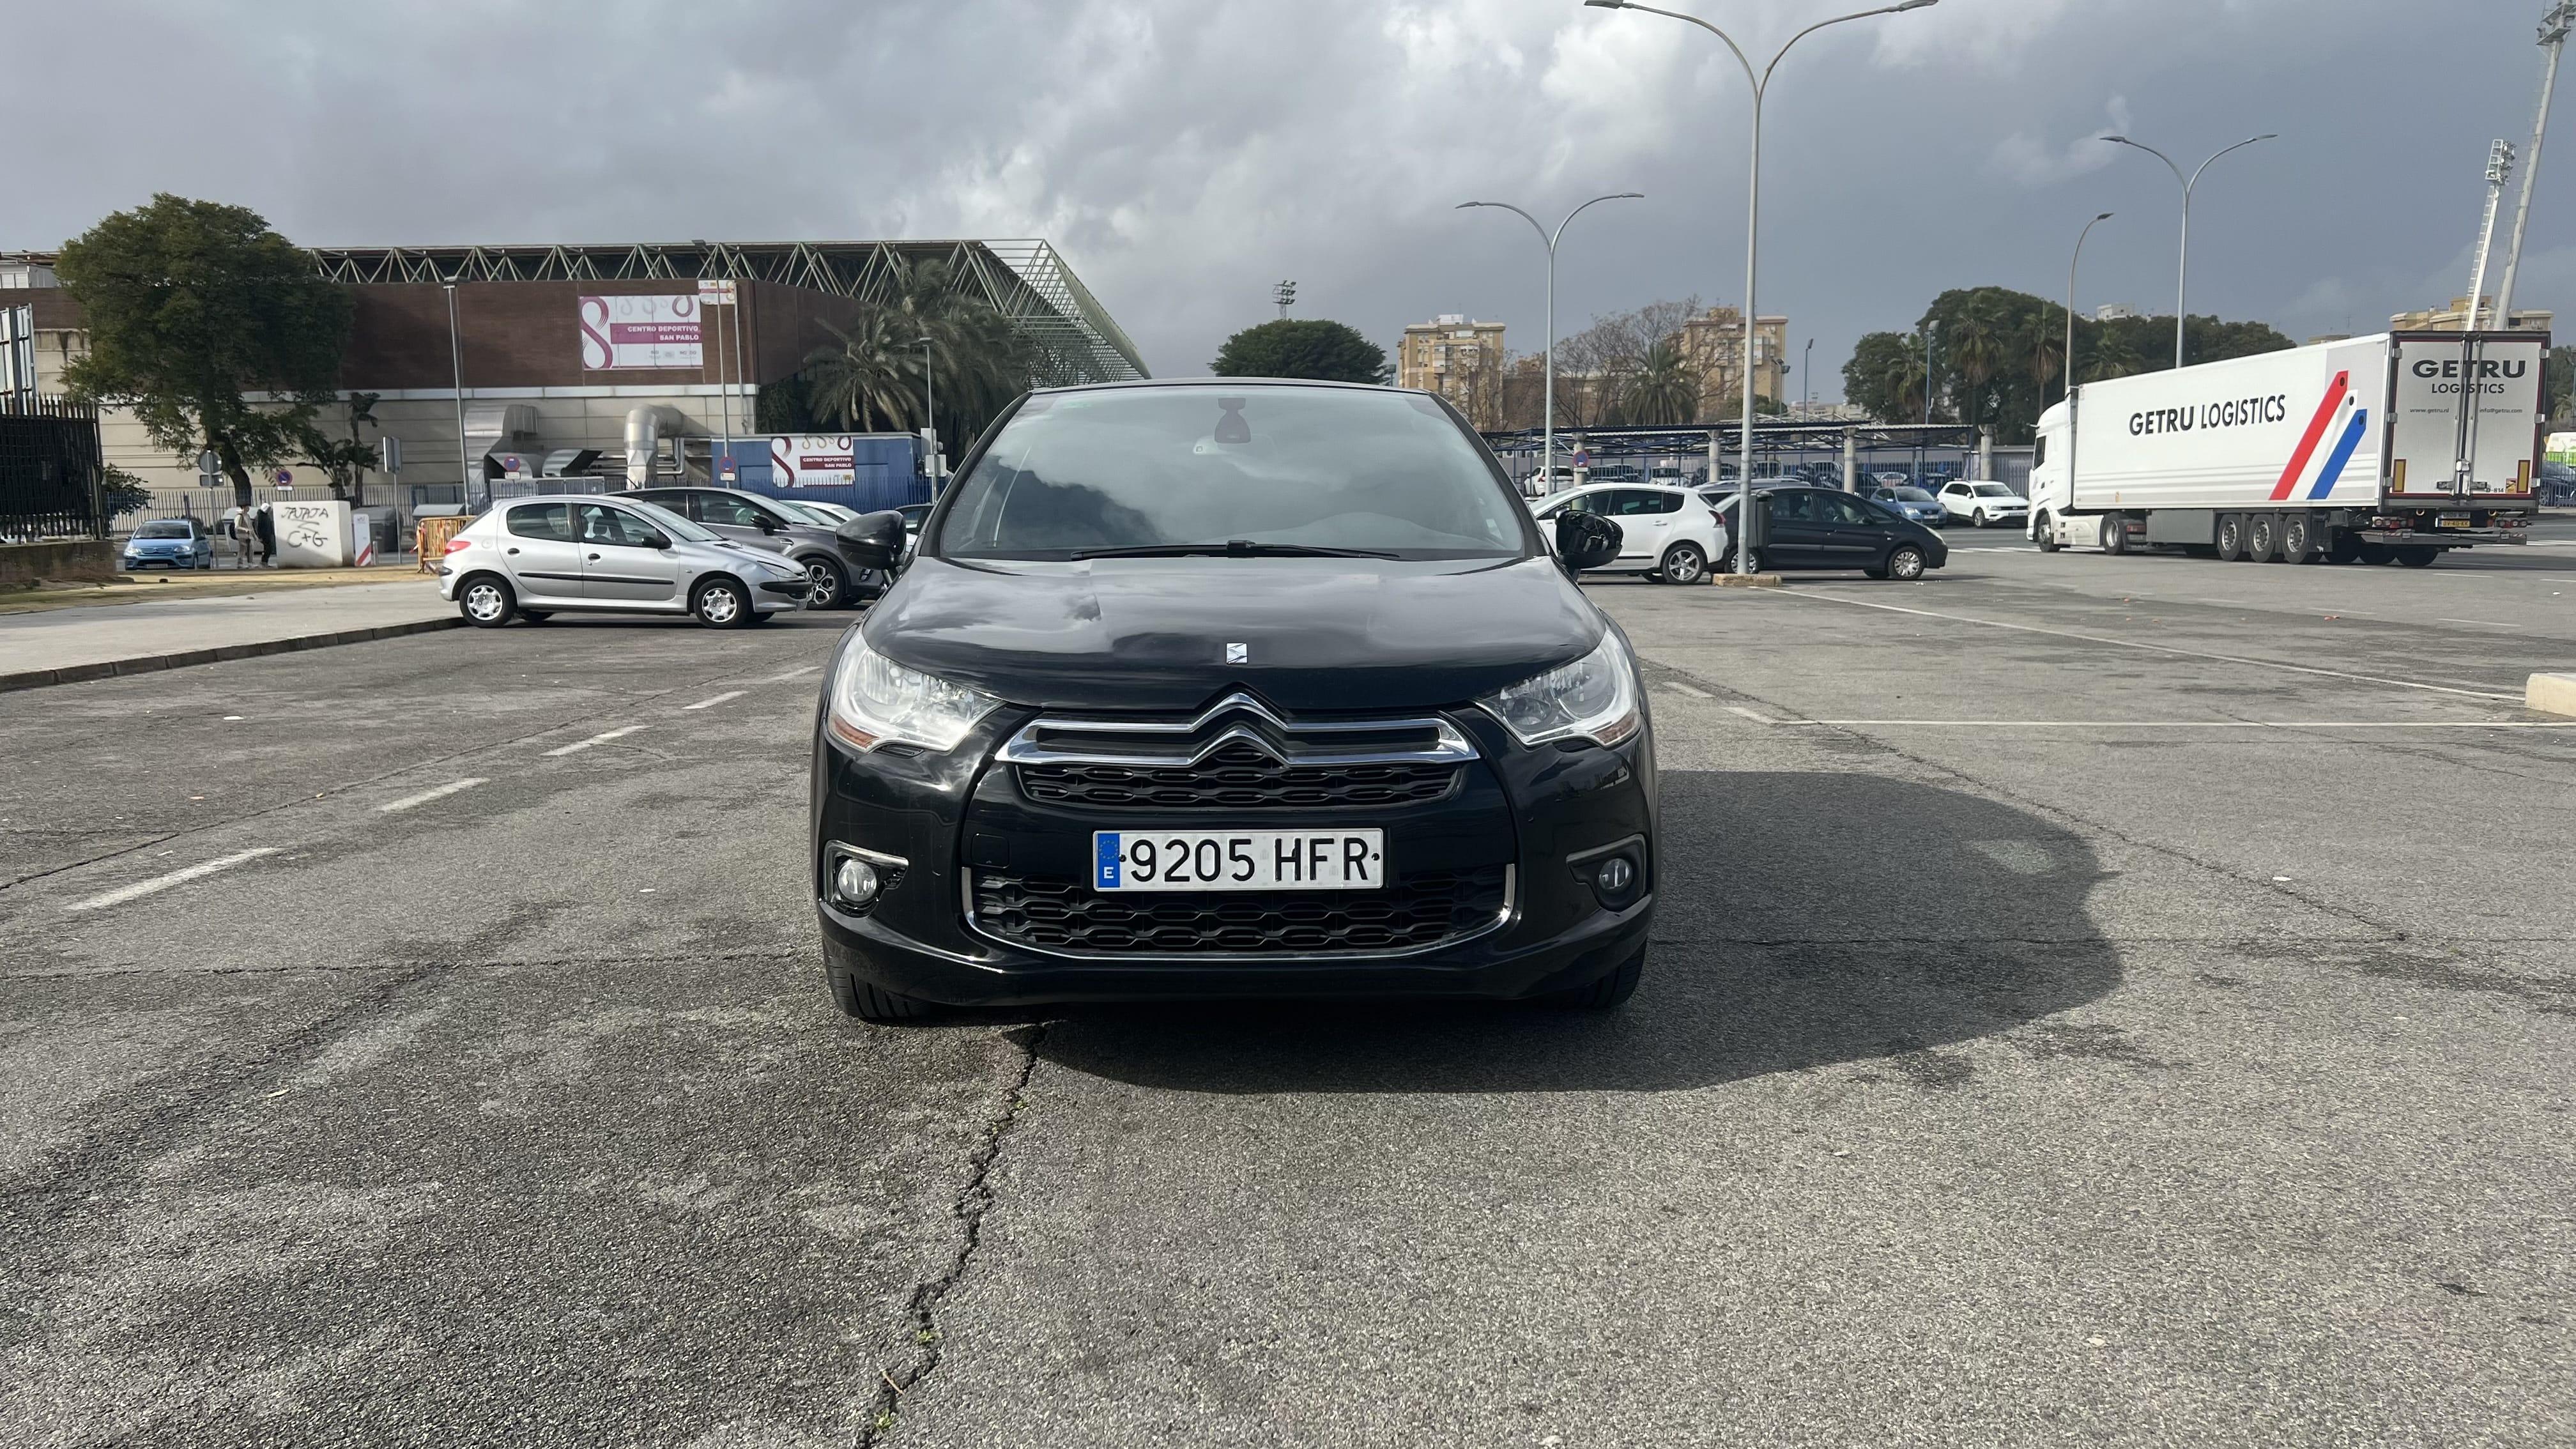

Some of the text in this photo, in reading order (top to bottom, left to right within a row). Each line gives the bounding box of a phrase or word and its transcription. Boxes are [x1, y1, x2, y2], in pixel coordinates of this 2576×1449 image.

[2412, 360, 2526, 378] GETRU
[2432, 383, 2504, 394] LOGISTICS
[2129, 394, 2285, 436] GETRU LOGISTICS
[288, 531, 328, 548] C+G
[1103, 838, 1368, 882] E 9205 HFR
